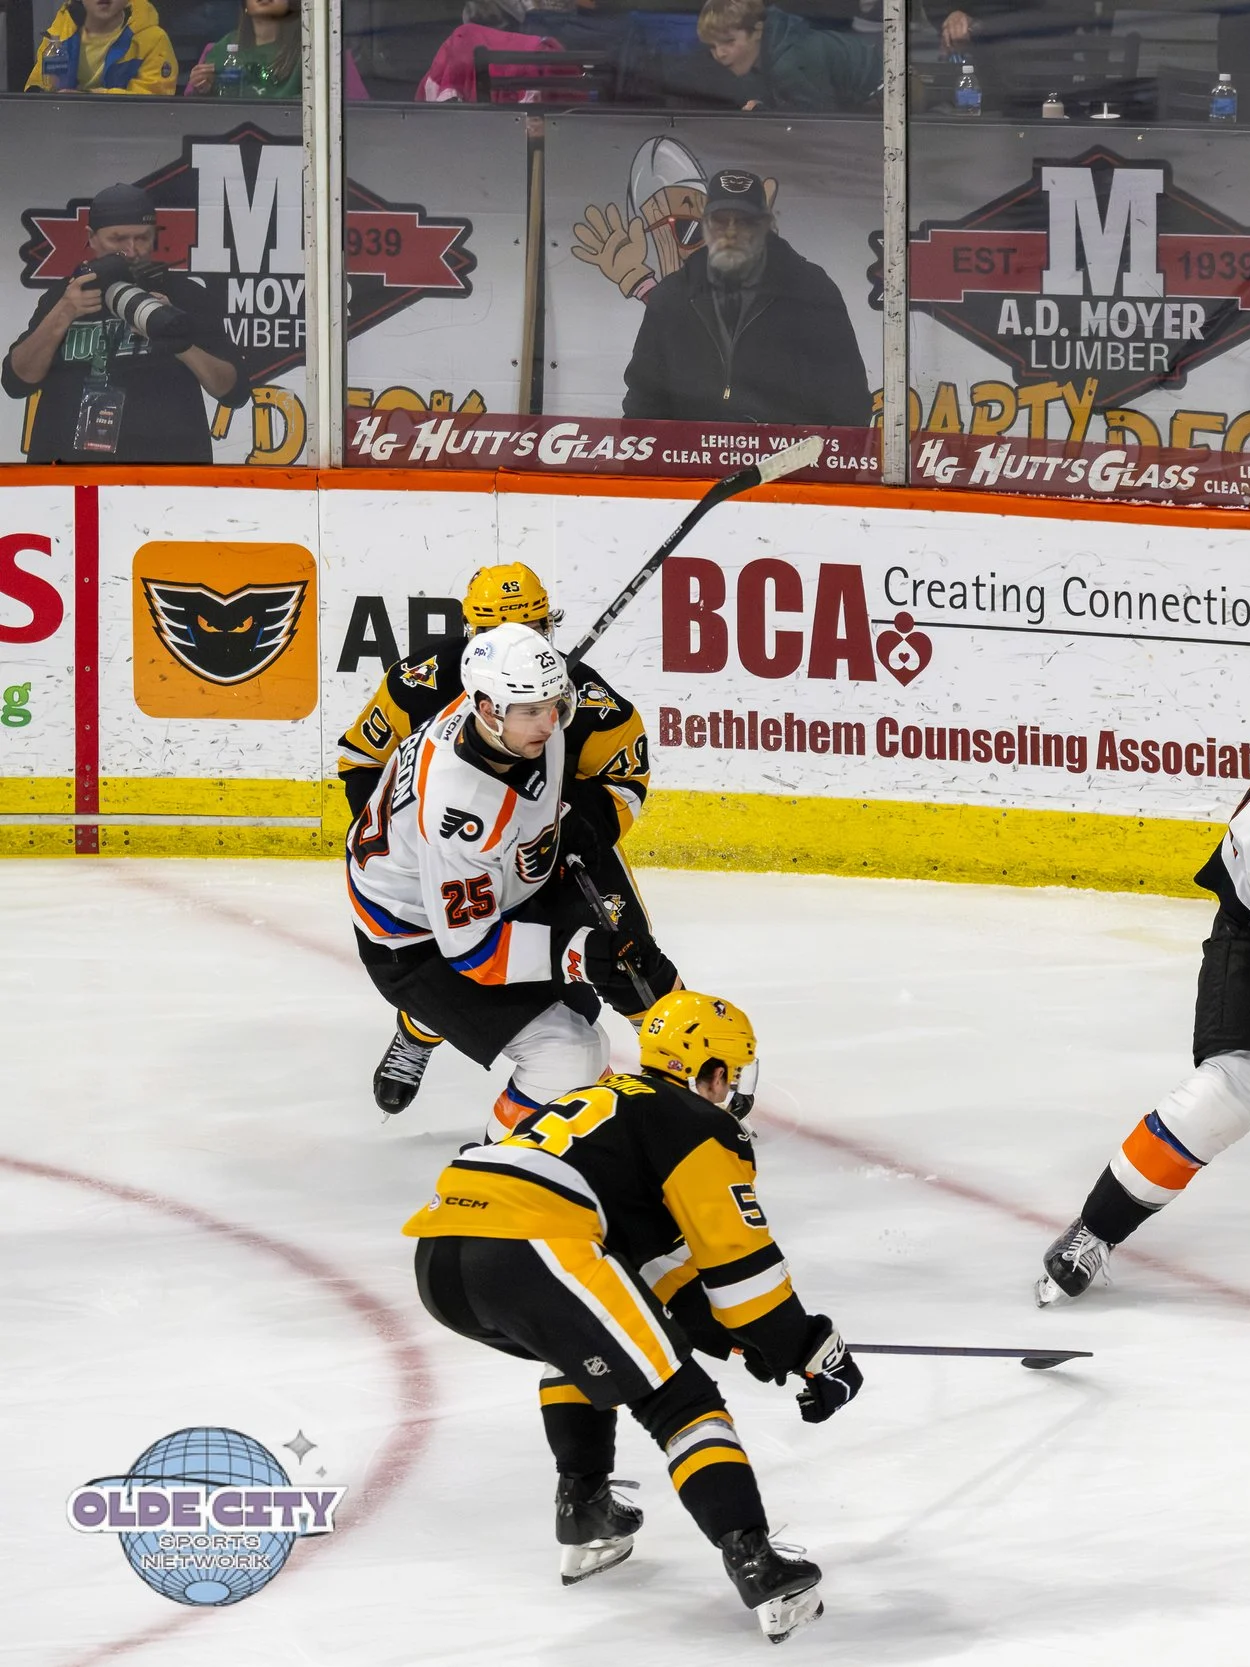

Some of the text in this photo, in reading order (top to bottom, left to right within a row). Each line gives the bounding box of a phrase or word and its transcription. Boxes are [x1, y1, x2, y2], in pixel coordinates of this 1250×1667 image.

[191, 144, 305, 273] M
[1042, 167, 1164, 298] M
[953, 247, 1017, 274] EST
[997, 298, 1205, 340] A.D. MOYER
[1030, 340, 1170, 372] LUMBER
[408, 418, 539, 462] HUTT'S
[537, 422, 657, 465] GLASS
[662, 450, 712, 464] CLEAR
[827, 456, 879, 470] GLASS
[701, 435, 760, 450] LEHIGH
[968, 442, 1090, 487] HUTT'S
[1087, 449, 1200, 492] GLASS
[499, 602, 529, 612] CCM
[884, 566, 1046, 626] Creating
[662, 556, 877, 682] BCA
[535, 651, 556, 669] 25
[1, 682, 32, 727] g
[659, 706, 866, 756] Bethlehem
[876, 716, 1088, 773] Counseling
[441, 873, 497, 928] 25
[445, 1196, 489, 1210] CCM
